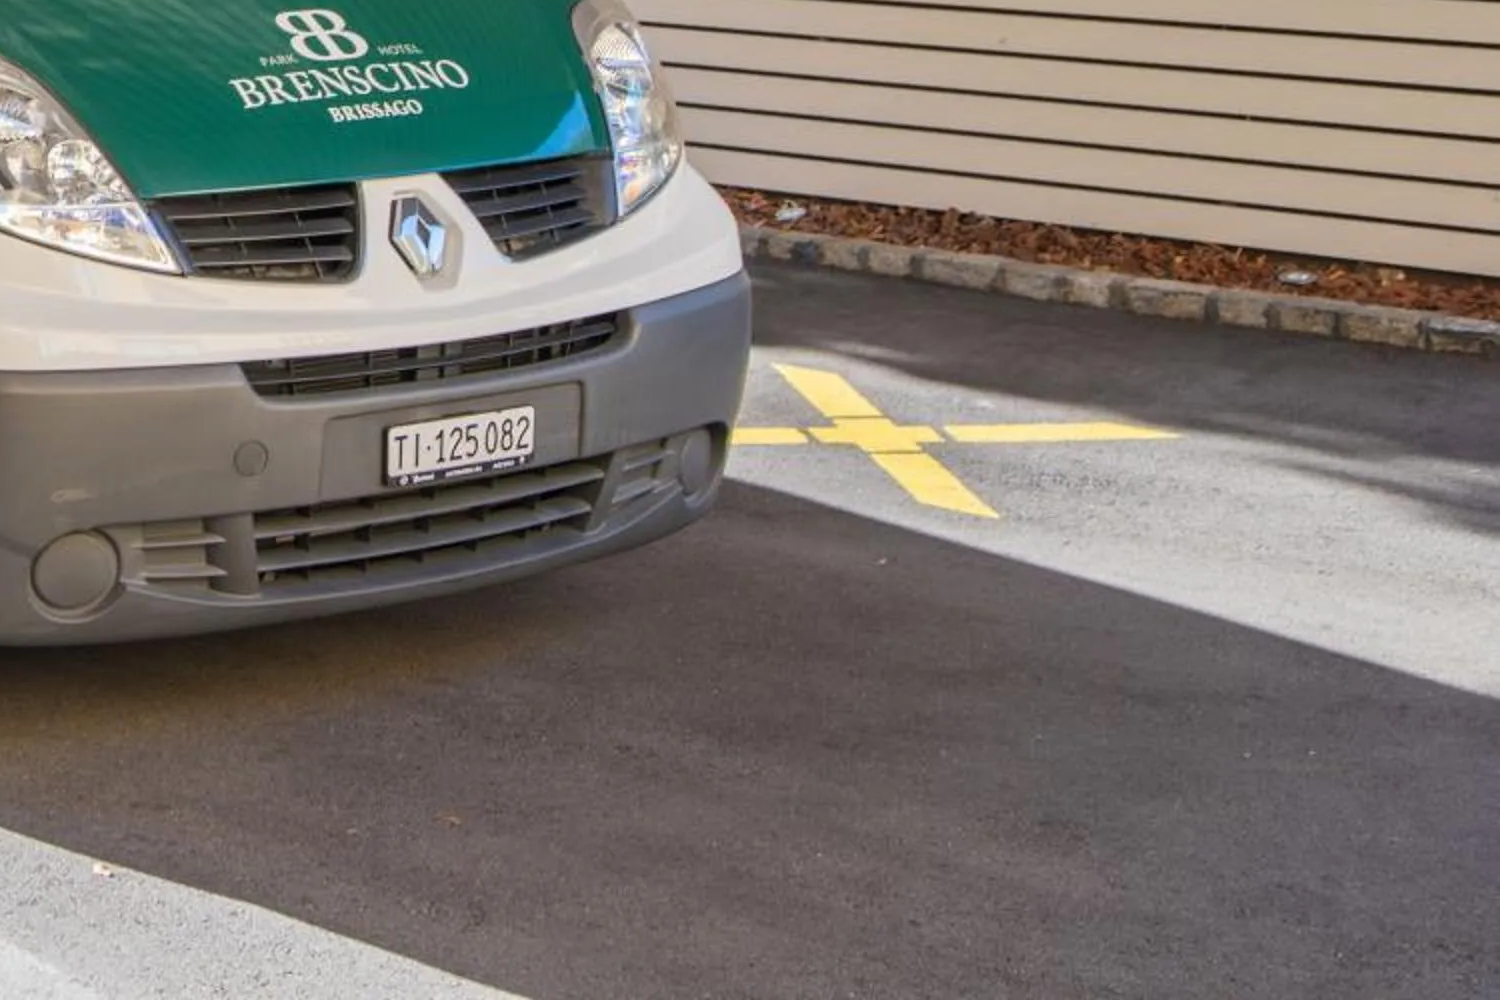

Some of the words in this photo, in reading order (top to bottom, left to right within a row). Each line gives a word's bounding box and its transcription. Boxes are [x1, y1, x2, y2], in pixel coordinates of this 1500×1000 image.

[259, 53, 299, 67] PARK
[377, 43, 423, 56] HOTEL
[228, 59, 469, 110] BRENSCINO
[328, 99, 424, 123] BRISSAGO
